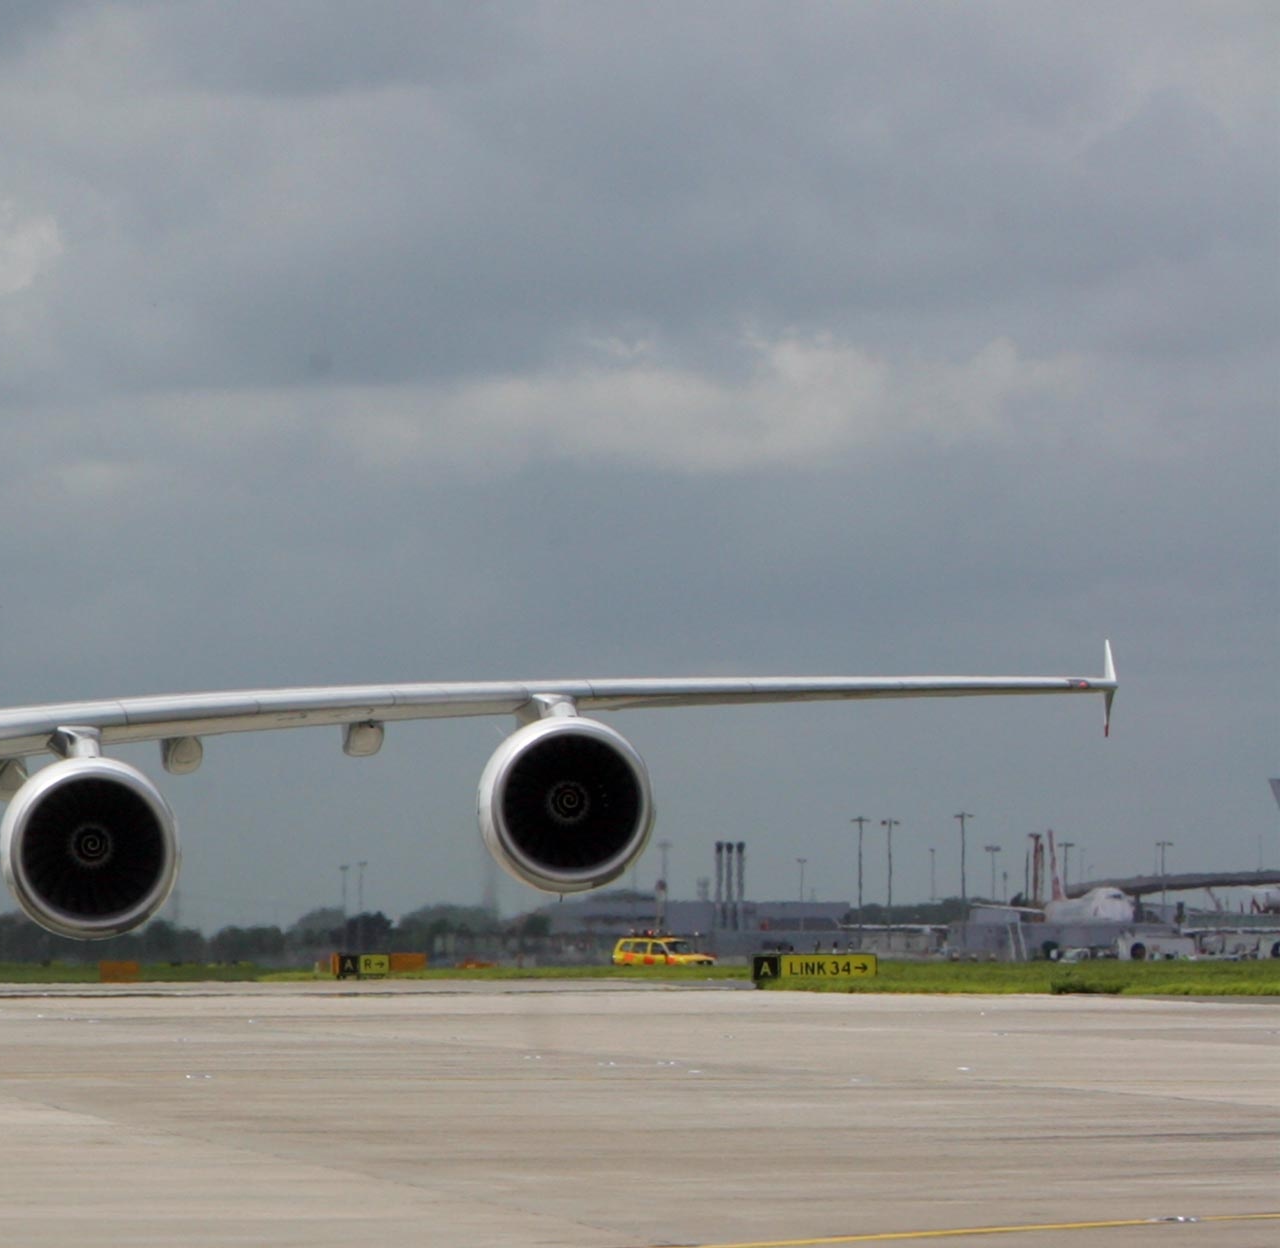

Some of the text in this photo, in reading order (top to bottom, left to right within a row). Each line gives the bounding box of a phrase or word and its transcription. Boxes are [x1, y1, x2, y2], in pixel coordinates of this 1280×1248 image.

[344, 958, 372, 970] A R
[760, 961, 851, 976] A LINK 34
